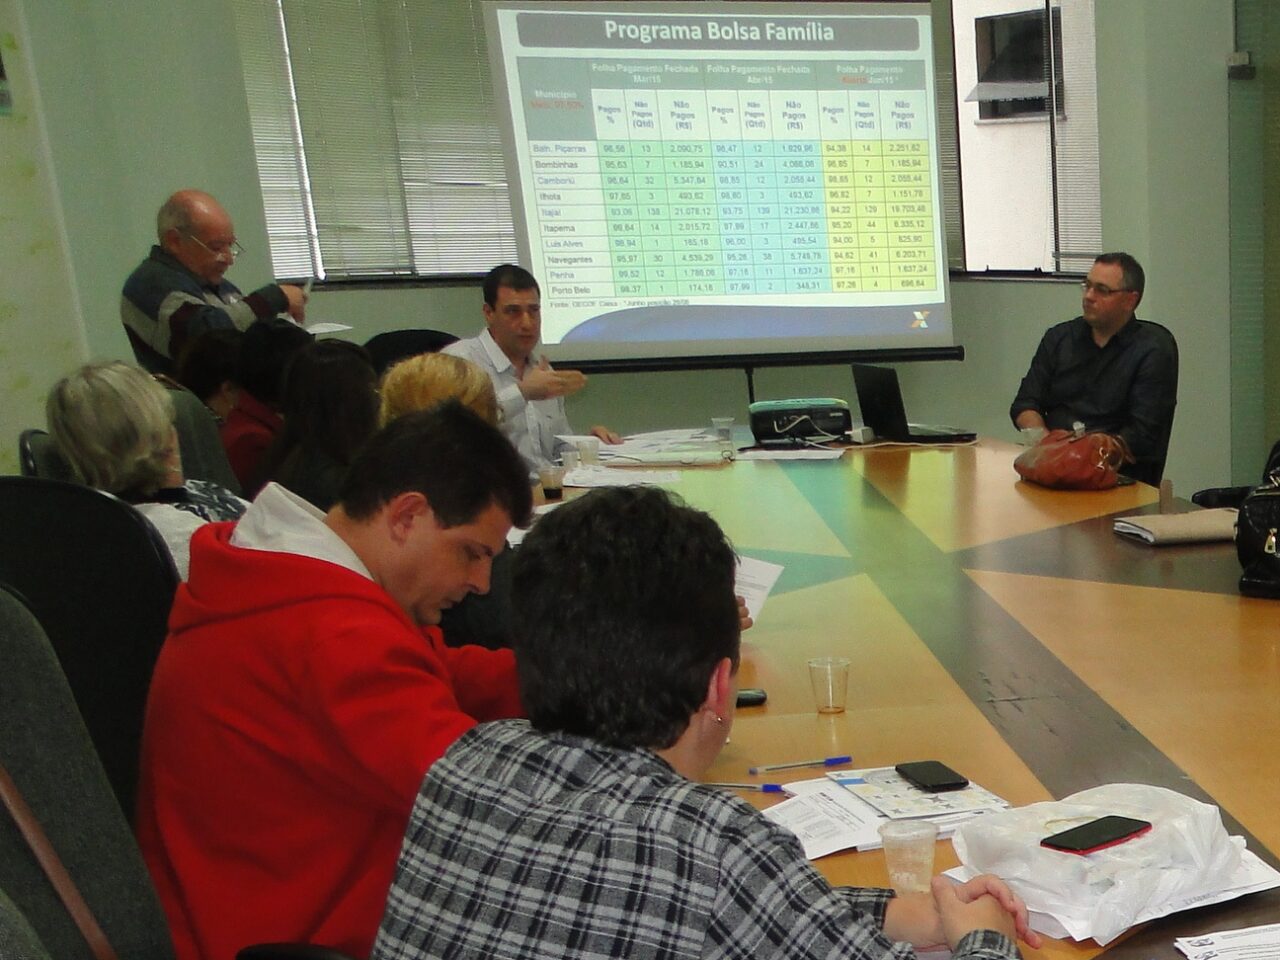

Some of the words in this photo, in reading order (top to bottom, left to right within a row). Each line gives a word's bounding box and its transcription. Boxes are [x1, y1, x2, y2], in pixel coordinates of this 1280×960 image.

[605, 20, 702, 43] Programa
[708, 22, 761, 41] Bolsa
[766, 21, 835, 41] Família
[592, 64, 617, 73] Folha
[617, 64, 664, 74] Pagamento
[664, 64, 699, 73] Fechada
[706, 64, 730, 73] Folha
[730, 65, 776, 74] Pagamento
[673, 100, 690, 109] Não
[785, 100, 802, 109] Não
[894, 100, 910, 109] Não
[597, 106, 621, 115] Pagos
[711, 106, 735, 115] Pagos
[822, 106, 845, 115] Pagos
[606, 116, 615, 124] %
[670, 111, 696, 120] Pagos
[719, 116, 728, 124] %
[782, 111, 806, 120] Pagos
[830, 116, 839, 124] %
[891, 111, 915, 120] Pagos
[632, 119, 655, 129] (Qtd)
[675, 121, 693, 131] (R$)
[745, 120, 766, 129] (Qtd)
[787, 121, 804, 131] (R$)
[855, 120, 875, 130] (Qtd)
[895, 121, 912, 131] (R$)
[753, 144, 763, 153] 12
[862, 144, 871, 152] 14
[535, 160, 579, 169] Bombinhas
[754, 160, 765, 168] 24
[644, 176, 655, 185] 32
[756, 175, 766, 184] 12
[864, 174, 873, 183] 12
[543, 224, 575, 233] Itapema
[650, 224, 660, 232] 14
[760, 221, 769, 230] 17
[867, 221, 877, 229] 44
[563, 239, 584, 248] Alves
[547, 255, 593, 265] Navegantes
[653, 254, 664, 263] 30
[869, 251, 878, 259] 41
[549, 271, 575, 279] Penha
[655, 270, 665, 278] 12
[871, 266, 879, 274] 11
[551, 286, 573, 294] Porto
[573, 286, 591, 294] Belo
